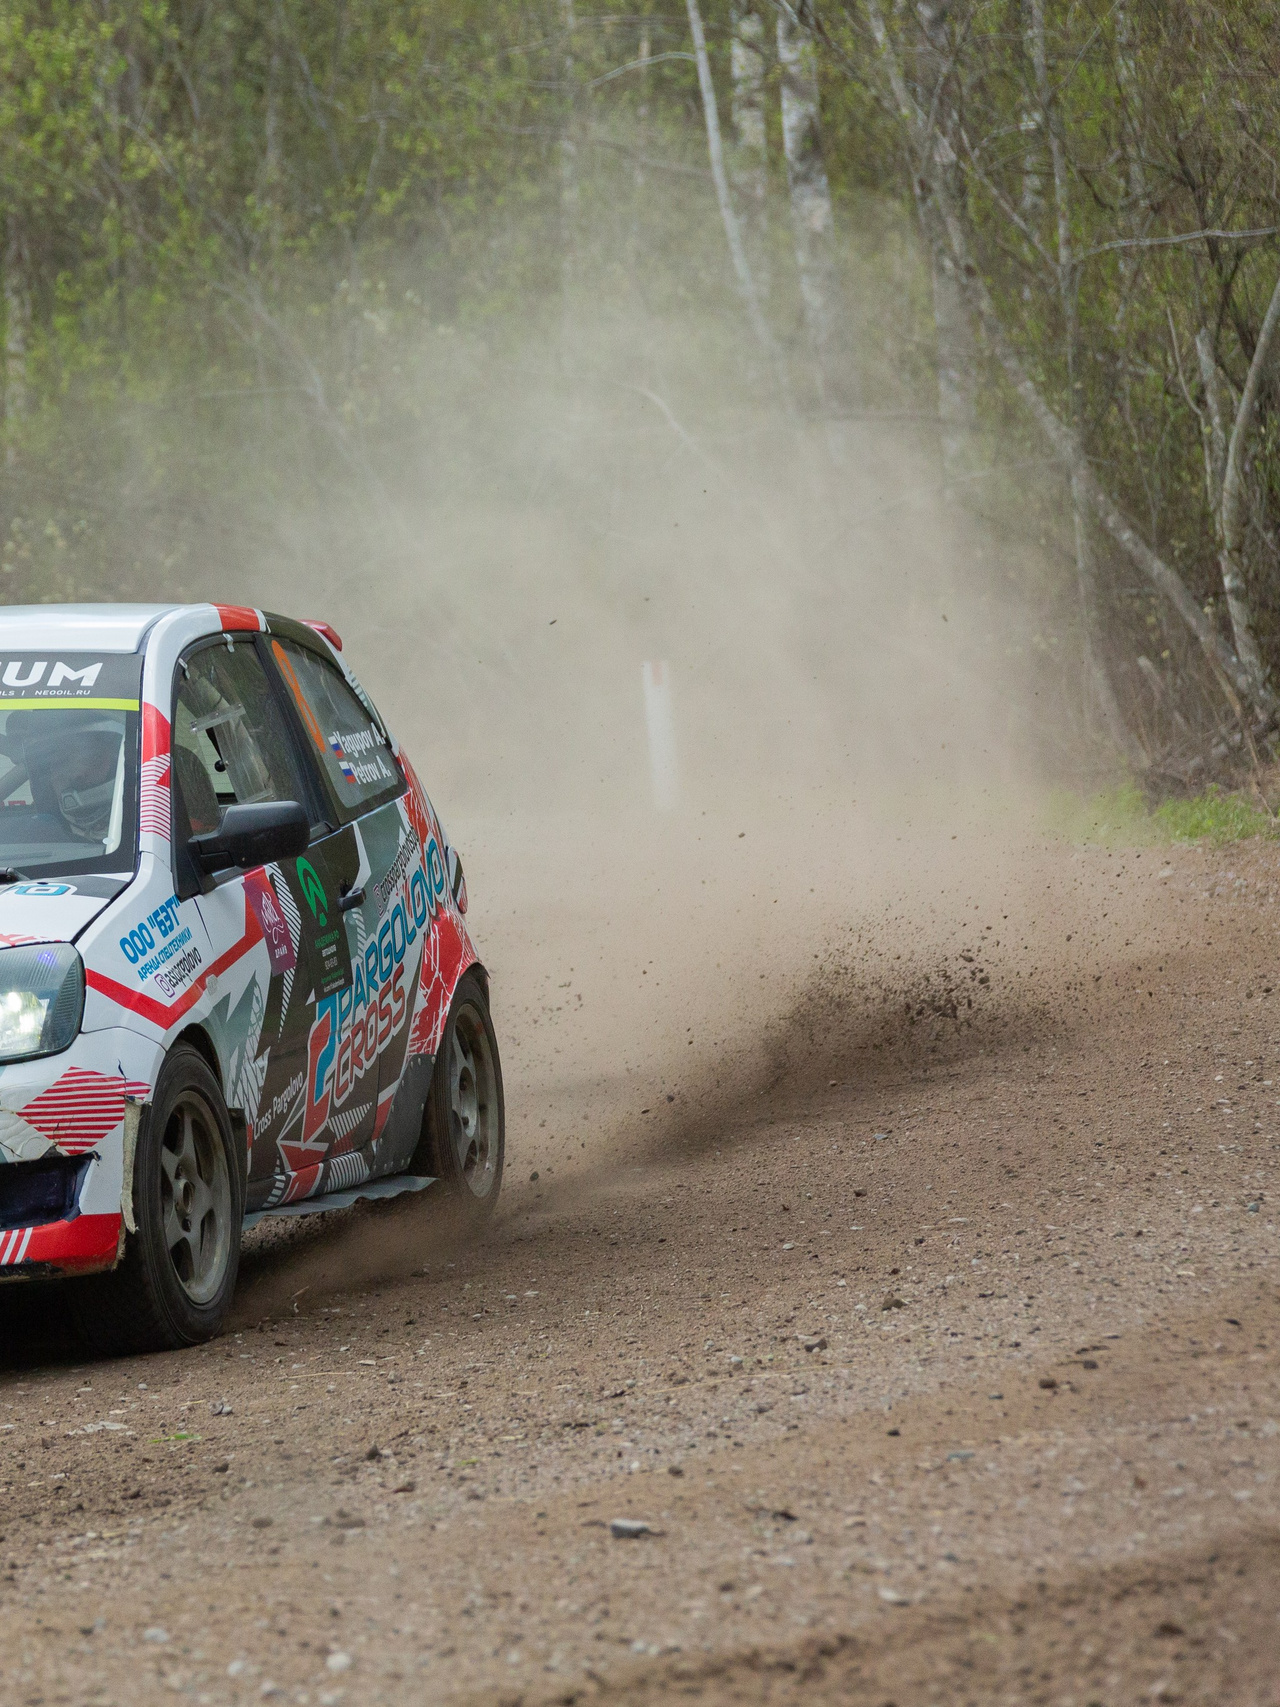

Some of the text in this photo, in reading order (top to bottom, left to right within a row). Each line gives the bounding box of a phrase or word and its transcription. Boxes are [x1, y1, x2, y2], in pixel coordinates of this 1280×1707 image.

[333, 729, 374, 758] Yagupov
[348, 755, 391, 785] Petrov A.
[137, 926, 193, 982] АРЕНДА СПЕЦТЕХНИКИ
[337, 837, 444, 1045] PARGOLOVO
[335, 963, 405, 1101] CROSS
[272, 1071, 303, 1120] Pargolovo
